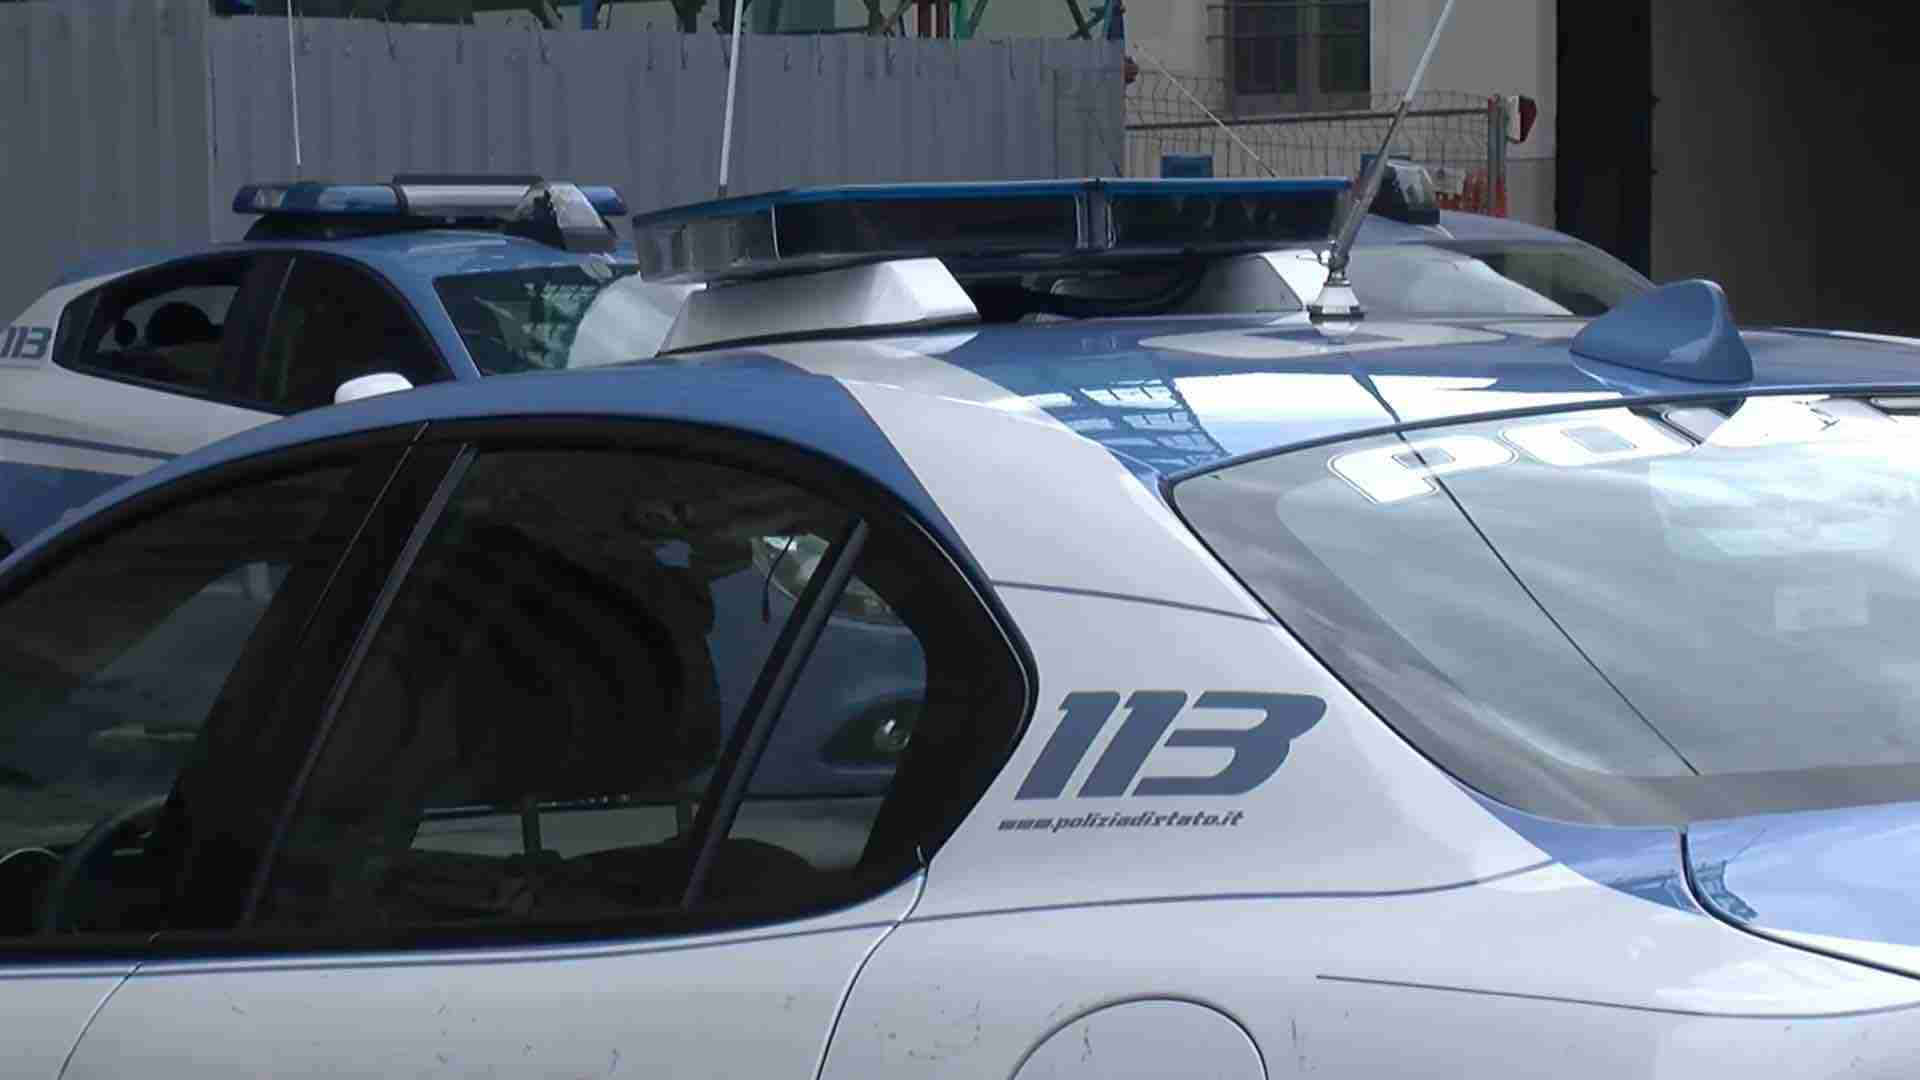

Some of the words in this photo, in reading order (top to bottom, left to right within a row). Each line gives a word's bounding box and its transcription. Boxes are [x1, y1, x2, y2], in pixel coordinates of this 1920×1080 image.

[0, 327, 52, 358] 113
[1013, 690, 1328, 801] 113
[997, 809, 1245, 833] www.poliziadistato.it
